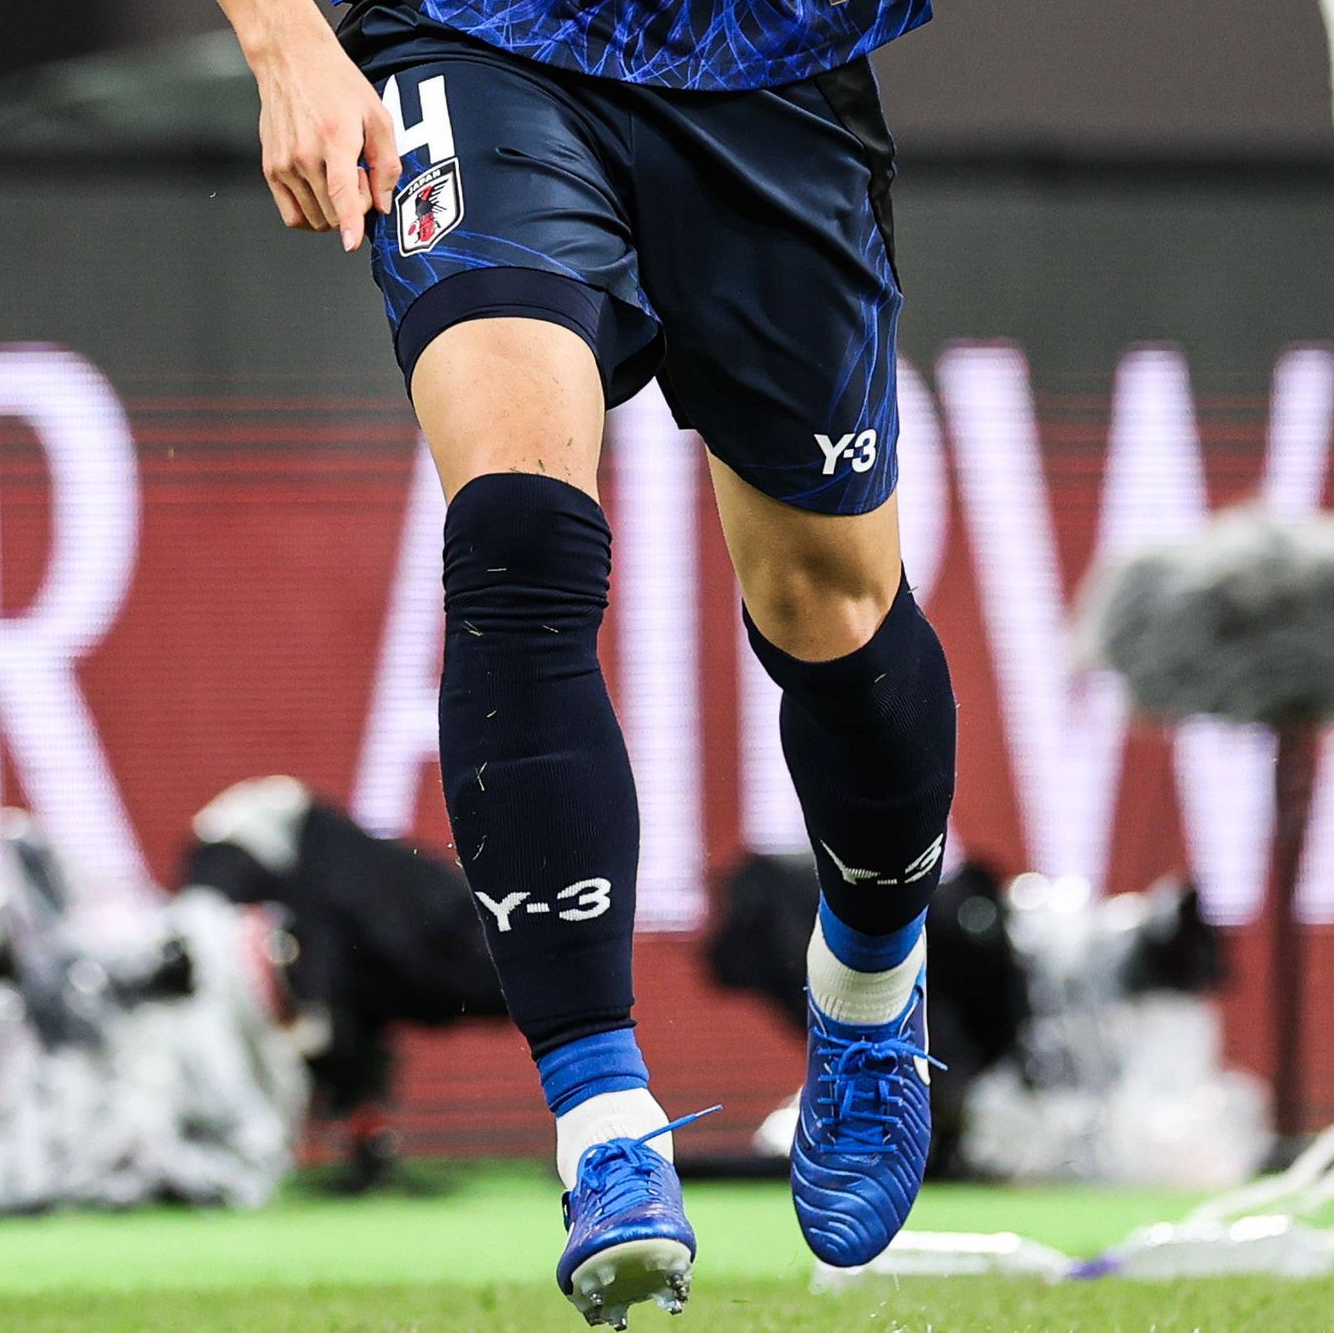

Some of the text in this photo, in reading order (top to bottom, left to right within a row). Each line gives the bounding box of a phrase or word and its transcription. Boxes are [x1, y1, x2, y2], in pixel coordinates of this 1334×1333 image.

[381, 74, 455, 164] 4
[408, 169, 441, 195] JAPAN
[813, 429, 877, 475] Y-3
[820, 833, 944, 886] Y-3
[474, 877, 612, 932] Y-3
